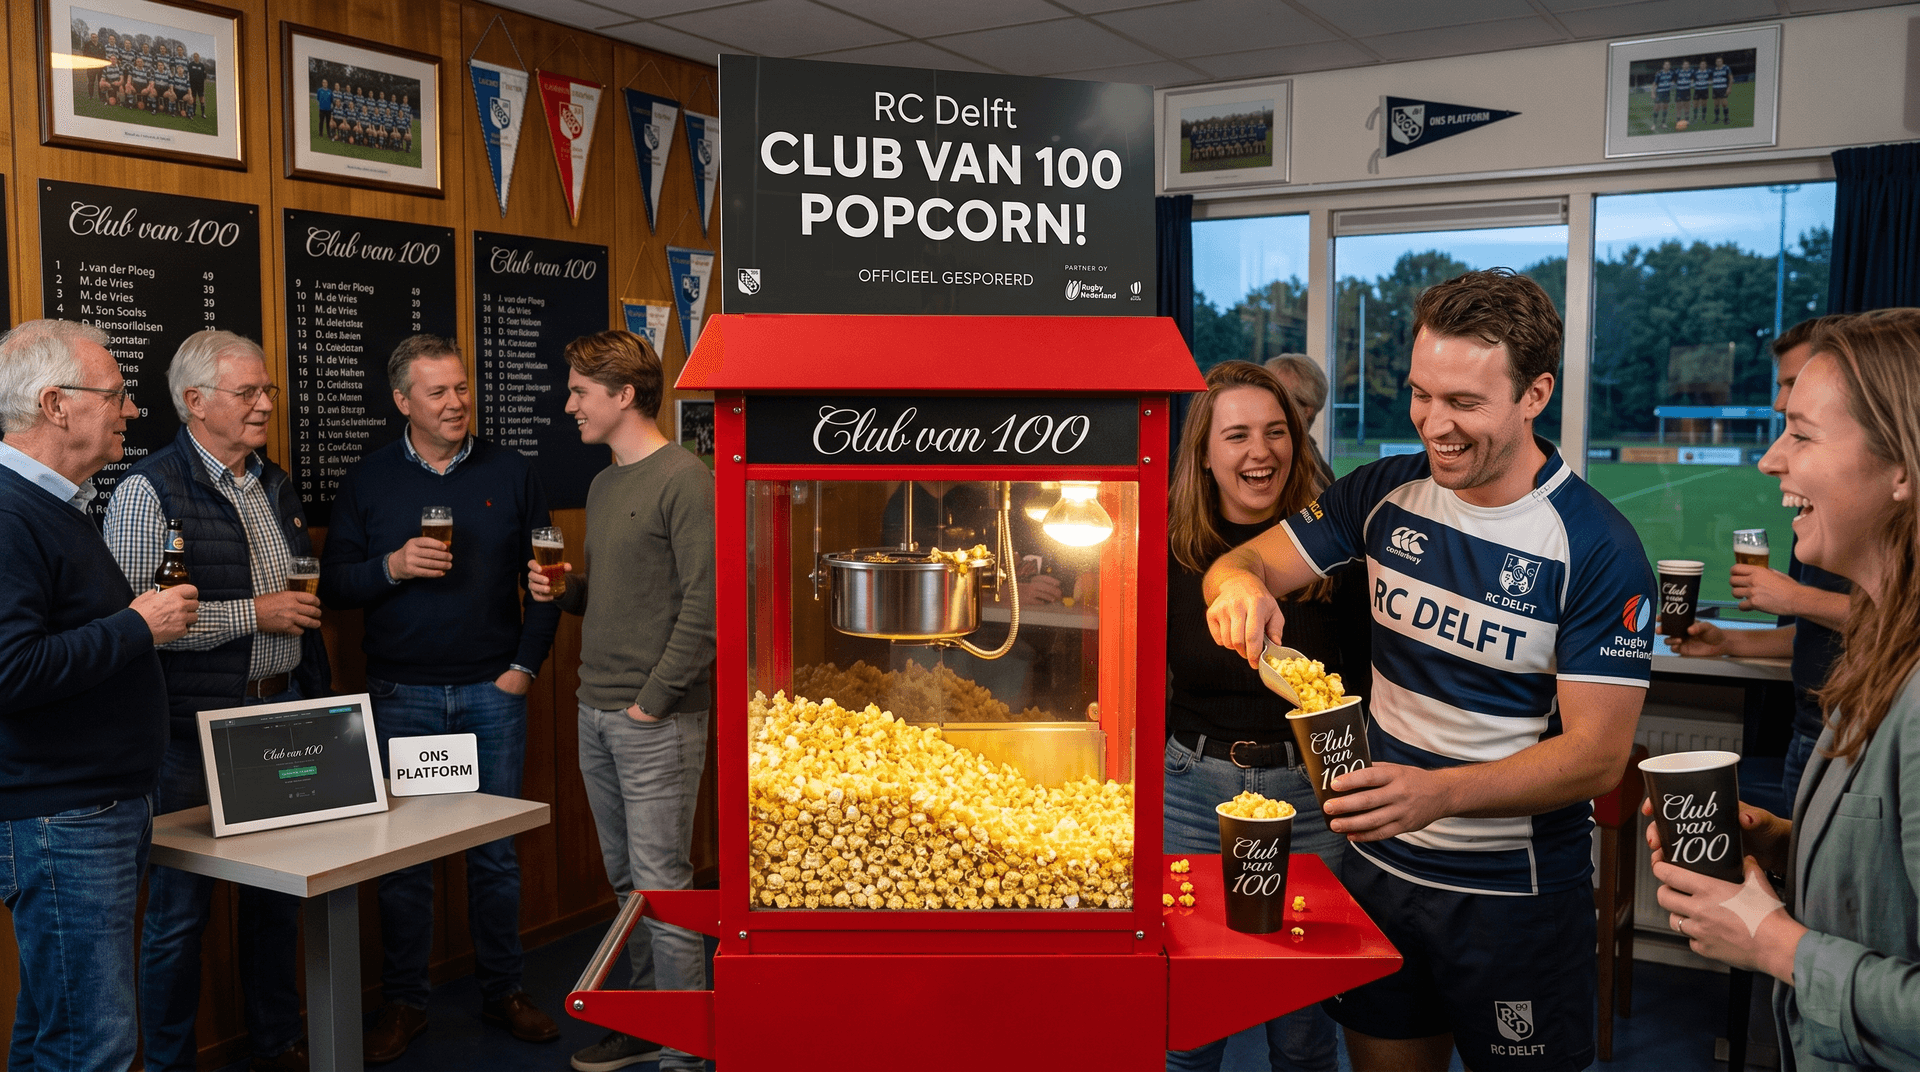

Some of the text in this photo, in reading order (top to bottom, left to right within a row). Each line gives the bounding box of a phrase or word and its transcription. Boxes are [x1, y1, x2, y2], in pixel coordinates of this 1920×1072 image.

[875, 91, 1018, 129] RC Delft
[1429, 112, 1490, 126] ONS PLATFORM
[761, 131, 1122, 190] CLUB VAN 100
[68, 201, 240, 247] Club van 100
[801, 192, 1087, 246] POPCORN!
[305, 226, 441, 266] Club van 100
[55, 260, 214, 281] 1 J. van der Ploeg 49
[490, 246, 597, 280] Club van 100
[1064, 264, 1096, 272] PARTNER
[56, 275, 215, 294] 2 M. de Vries 39
[858, 268, 1034, 286] OFFICIEEL GESPORERD
[295, 279, 420, 296] 9 J. van der Ploeg 49
[1081, 284, 1104, 292] Rugby
[56, 289, 215, 307] 3 M. de Vries 39
[297, 292, 420, 308] 10 M. de Vries 39
[56, 304, 64, 313] 4
[81, 305, 94, 315] M.
[297, 304, 420, 319] 11 M. de Vries 29
[297, 317, 307, 325] 12
[315, 318, 325, 326] M.
[412, 323, 421, 331] 29
[297, 330, 307, 338] 13
[298, 343, 307, 351] 14
[298, 355, 358, 365] 15 H. de Vries
[298, 368, 308, 376] 16
[299, 381, 308, 389] 17
[317, 381, 325, 389] D.
[299, 393, 326, 401] 18 D.
[300, 406, 310, 414] 19
[318, 406, 326, 414] D.
[300, 419, 310, 427] 20
[812, 405, 1091, 455] Club van 100
[300, 431, 309, 439] 21
[300, 444, 310, 452] 22
[301, 456, 311, 464] 22
[302, 481, 312, 489] 30
[302, 494, 312, 502] 30
[1485, 592, 1537, 614] RC DELFT
[1661, 601, 1690, 615] 100
[1374, 577, 1527, 661] RC DELFT
[1615, 636, 1648, 649] Rugby
[1310, 724, 1355, 756] Club
[263, 748, 285, 761] Club
[304, 744, 324, 756] 100
[419, 750, 449, 762] ONS
[1322, 749, 1353, 765] van
[397, 765, 473, 780] PLATFORM
[1662, 791, 1719, 821] Club
[1676, 818, 1716, 835] van
[1233, 836, 1279, 860] Club
[1670, 833, 1730, 864] 100
[1242, 860, 1275, 872] van
[1232, 873, 1281, 896] 100
[1490, 1044, 1546, 1056] RC DELFT
